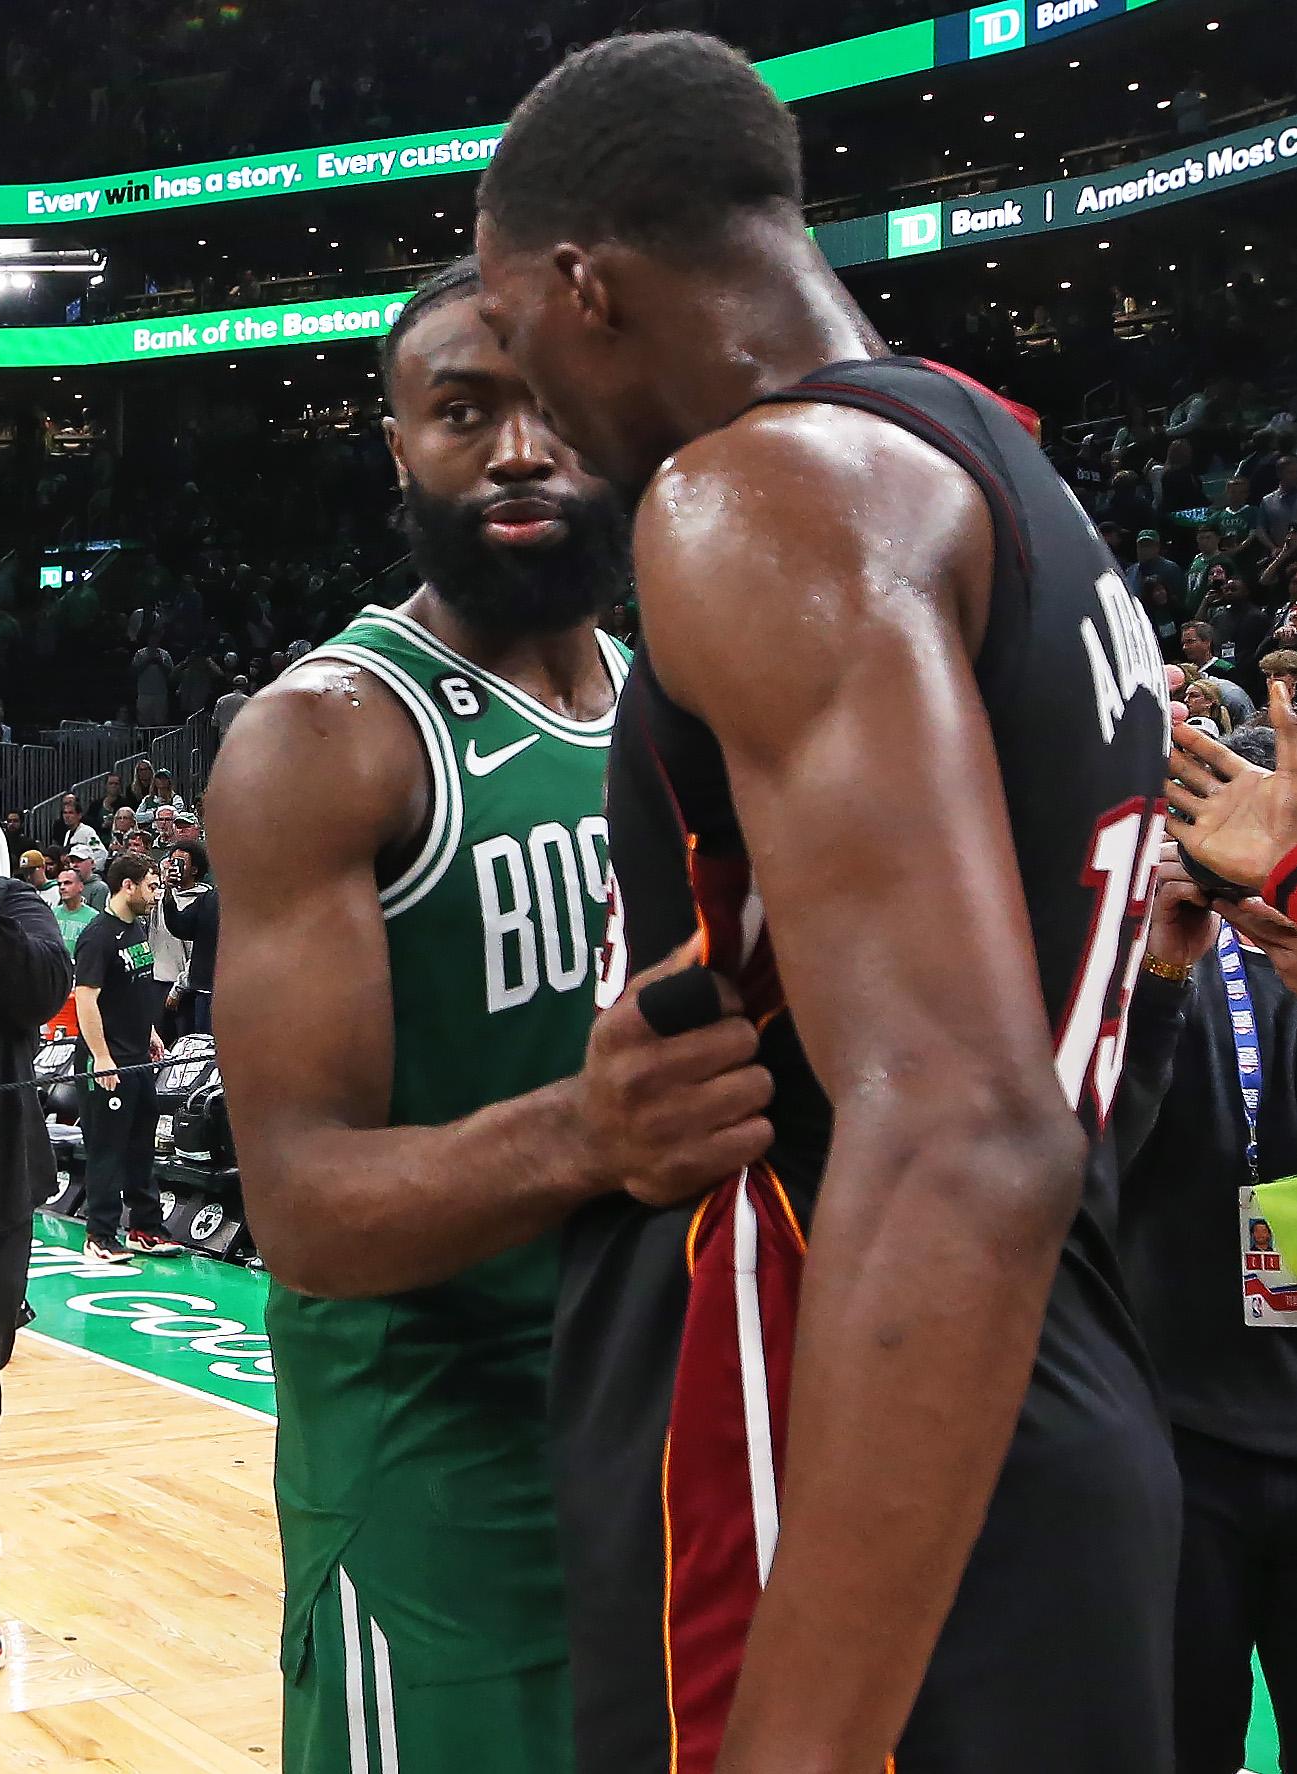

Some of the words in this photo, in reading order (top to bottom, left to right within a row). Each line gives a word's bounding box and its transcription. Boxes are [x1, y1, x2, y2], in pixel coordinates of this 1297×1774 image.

[974, 8, 1020, 46] TD
[1036, 0, 1099, 30] Bank
[27, 189, 100, 214] Every
[105, 179, 150, 207] win
[154, 175, 202, 199] has
[206, 174, 223, 193] a
[227, 163, 302, 191] story.
[317, 150, 397, 179] Every
[1075, 158, 1205, 215] America's
[1207, 137, 1276, 179] Most
[893, 211, 936, 248] TD
[951, 200, 1023, 235] Bank
[133, 323, 197, 352] Bank
[202, 319, 230, 344] of
[234, 317, 278, 341] the
[283, 309, 380, 337] Boston
[439, 676, 480, 717] 6
